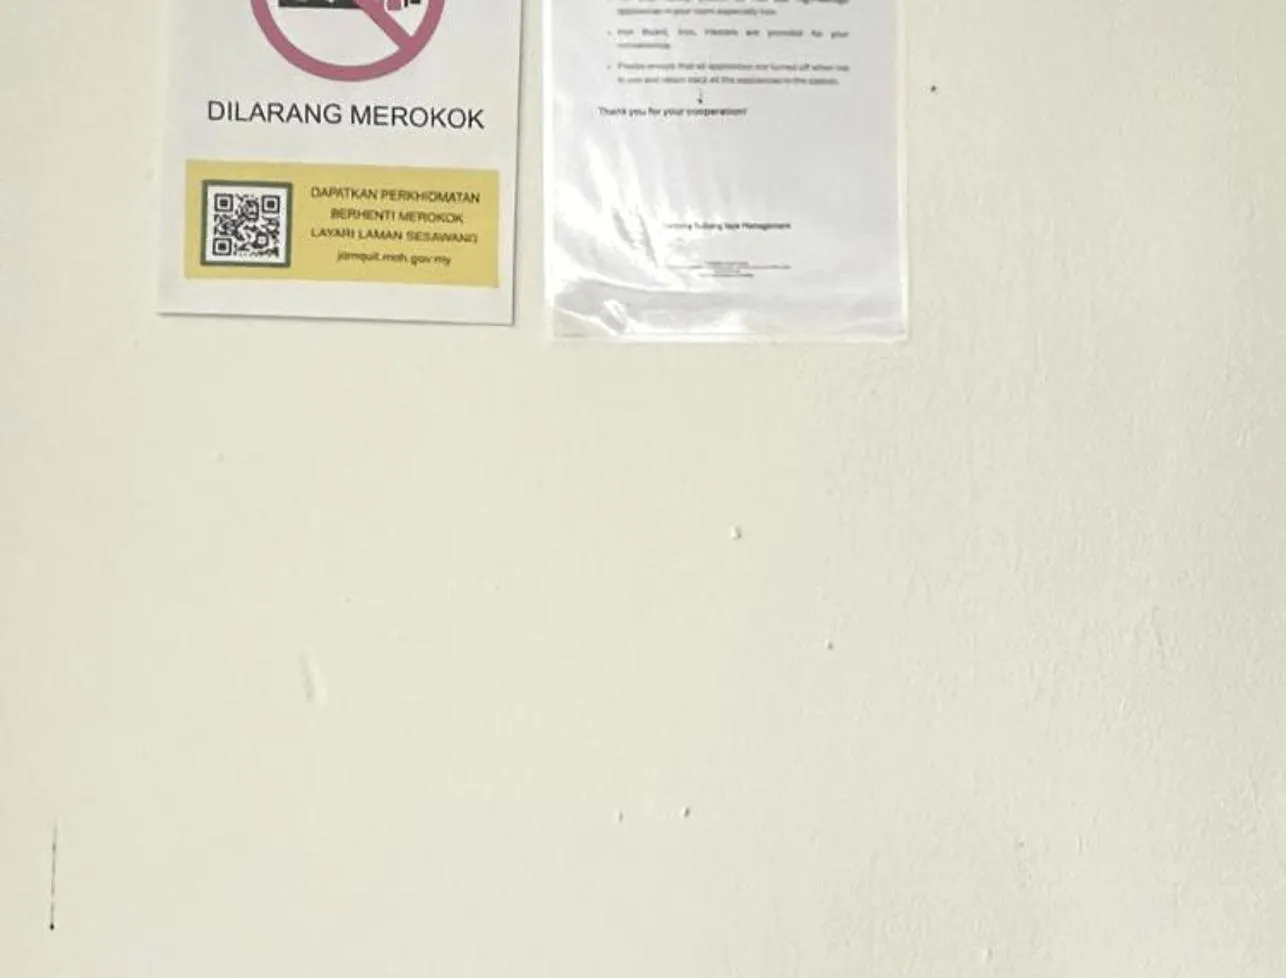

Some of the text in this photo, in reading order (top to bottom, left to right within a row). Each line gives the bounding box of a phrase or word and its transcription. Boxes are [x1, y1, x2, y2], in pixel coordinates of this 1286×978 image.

[207, 101, 485, 129] DILARANG MEROKOK
[311, 186, 481, 204] DAPATKAN PERKHIDMATAN
[330, 207, 464, 224] BERHENTI MEROKOK
[310, 227, 479, 244] LAYARI LAMAN SESAWANG
